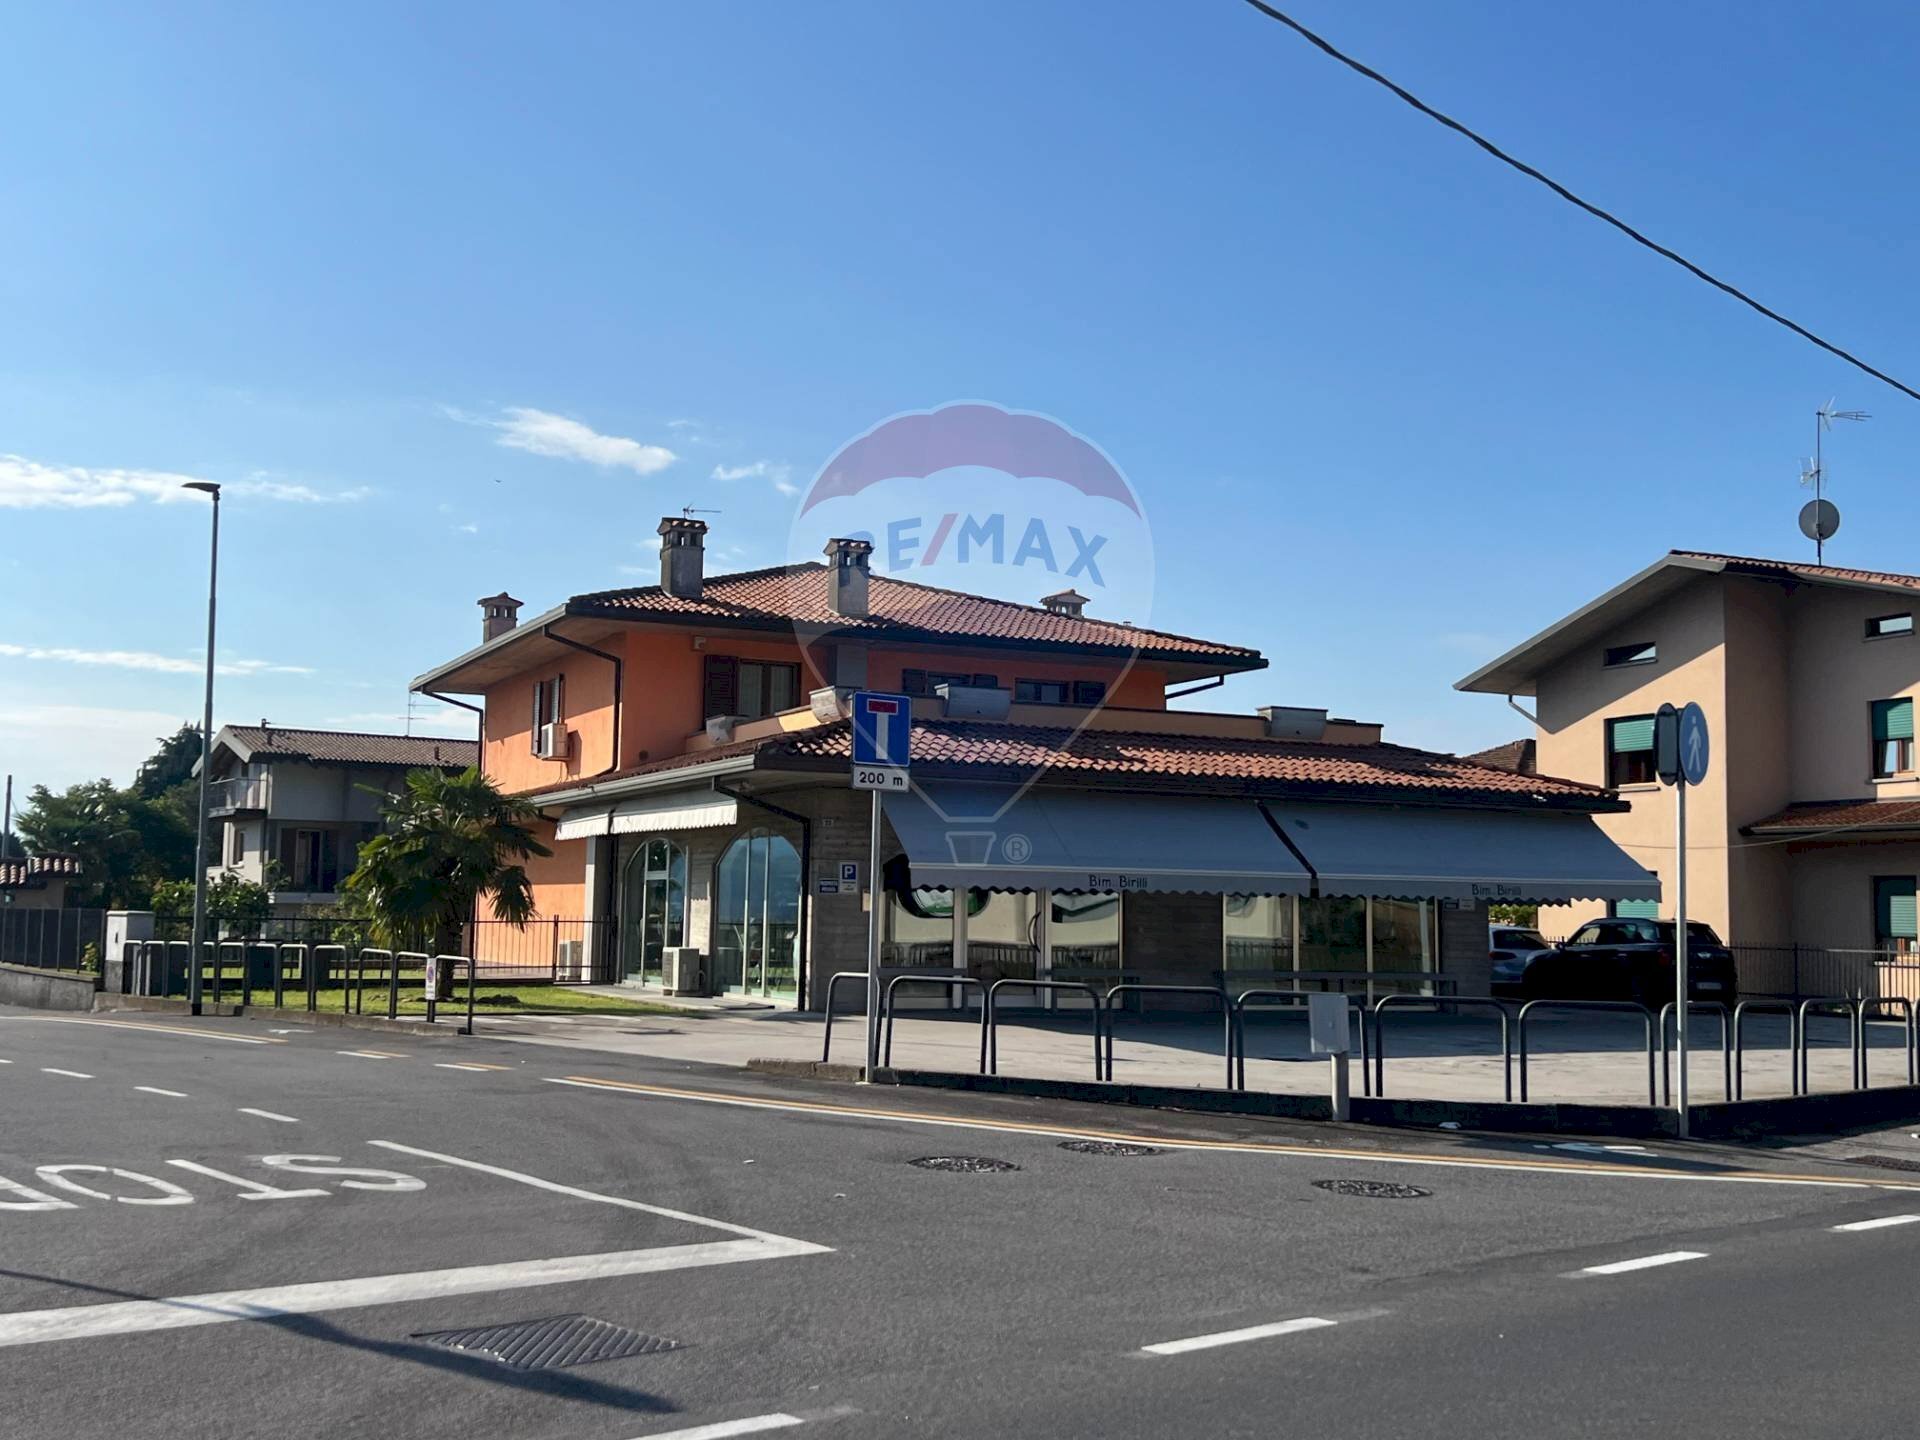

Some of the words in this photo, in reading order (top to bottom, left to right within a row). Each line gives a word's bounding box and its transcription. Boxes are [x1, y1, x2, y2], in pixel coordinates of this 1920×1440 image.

[859, 771, 885, 785] 200
[893, 776, 903, 787] m
[844, 866, 854, 879] P
